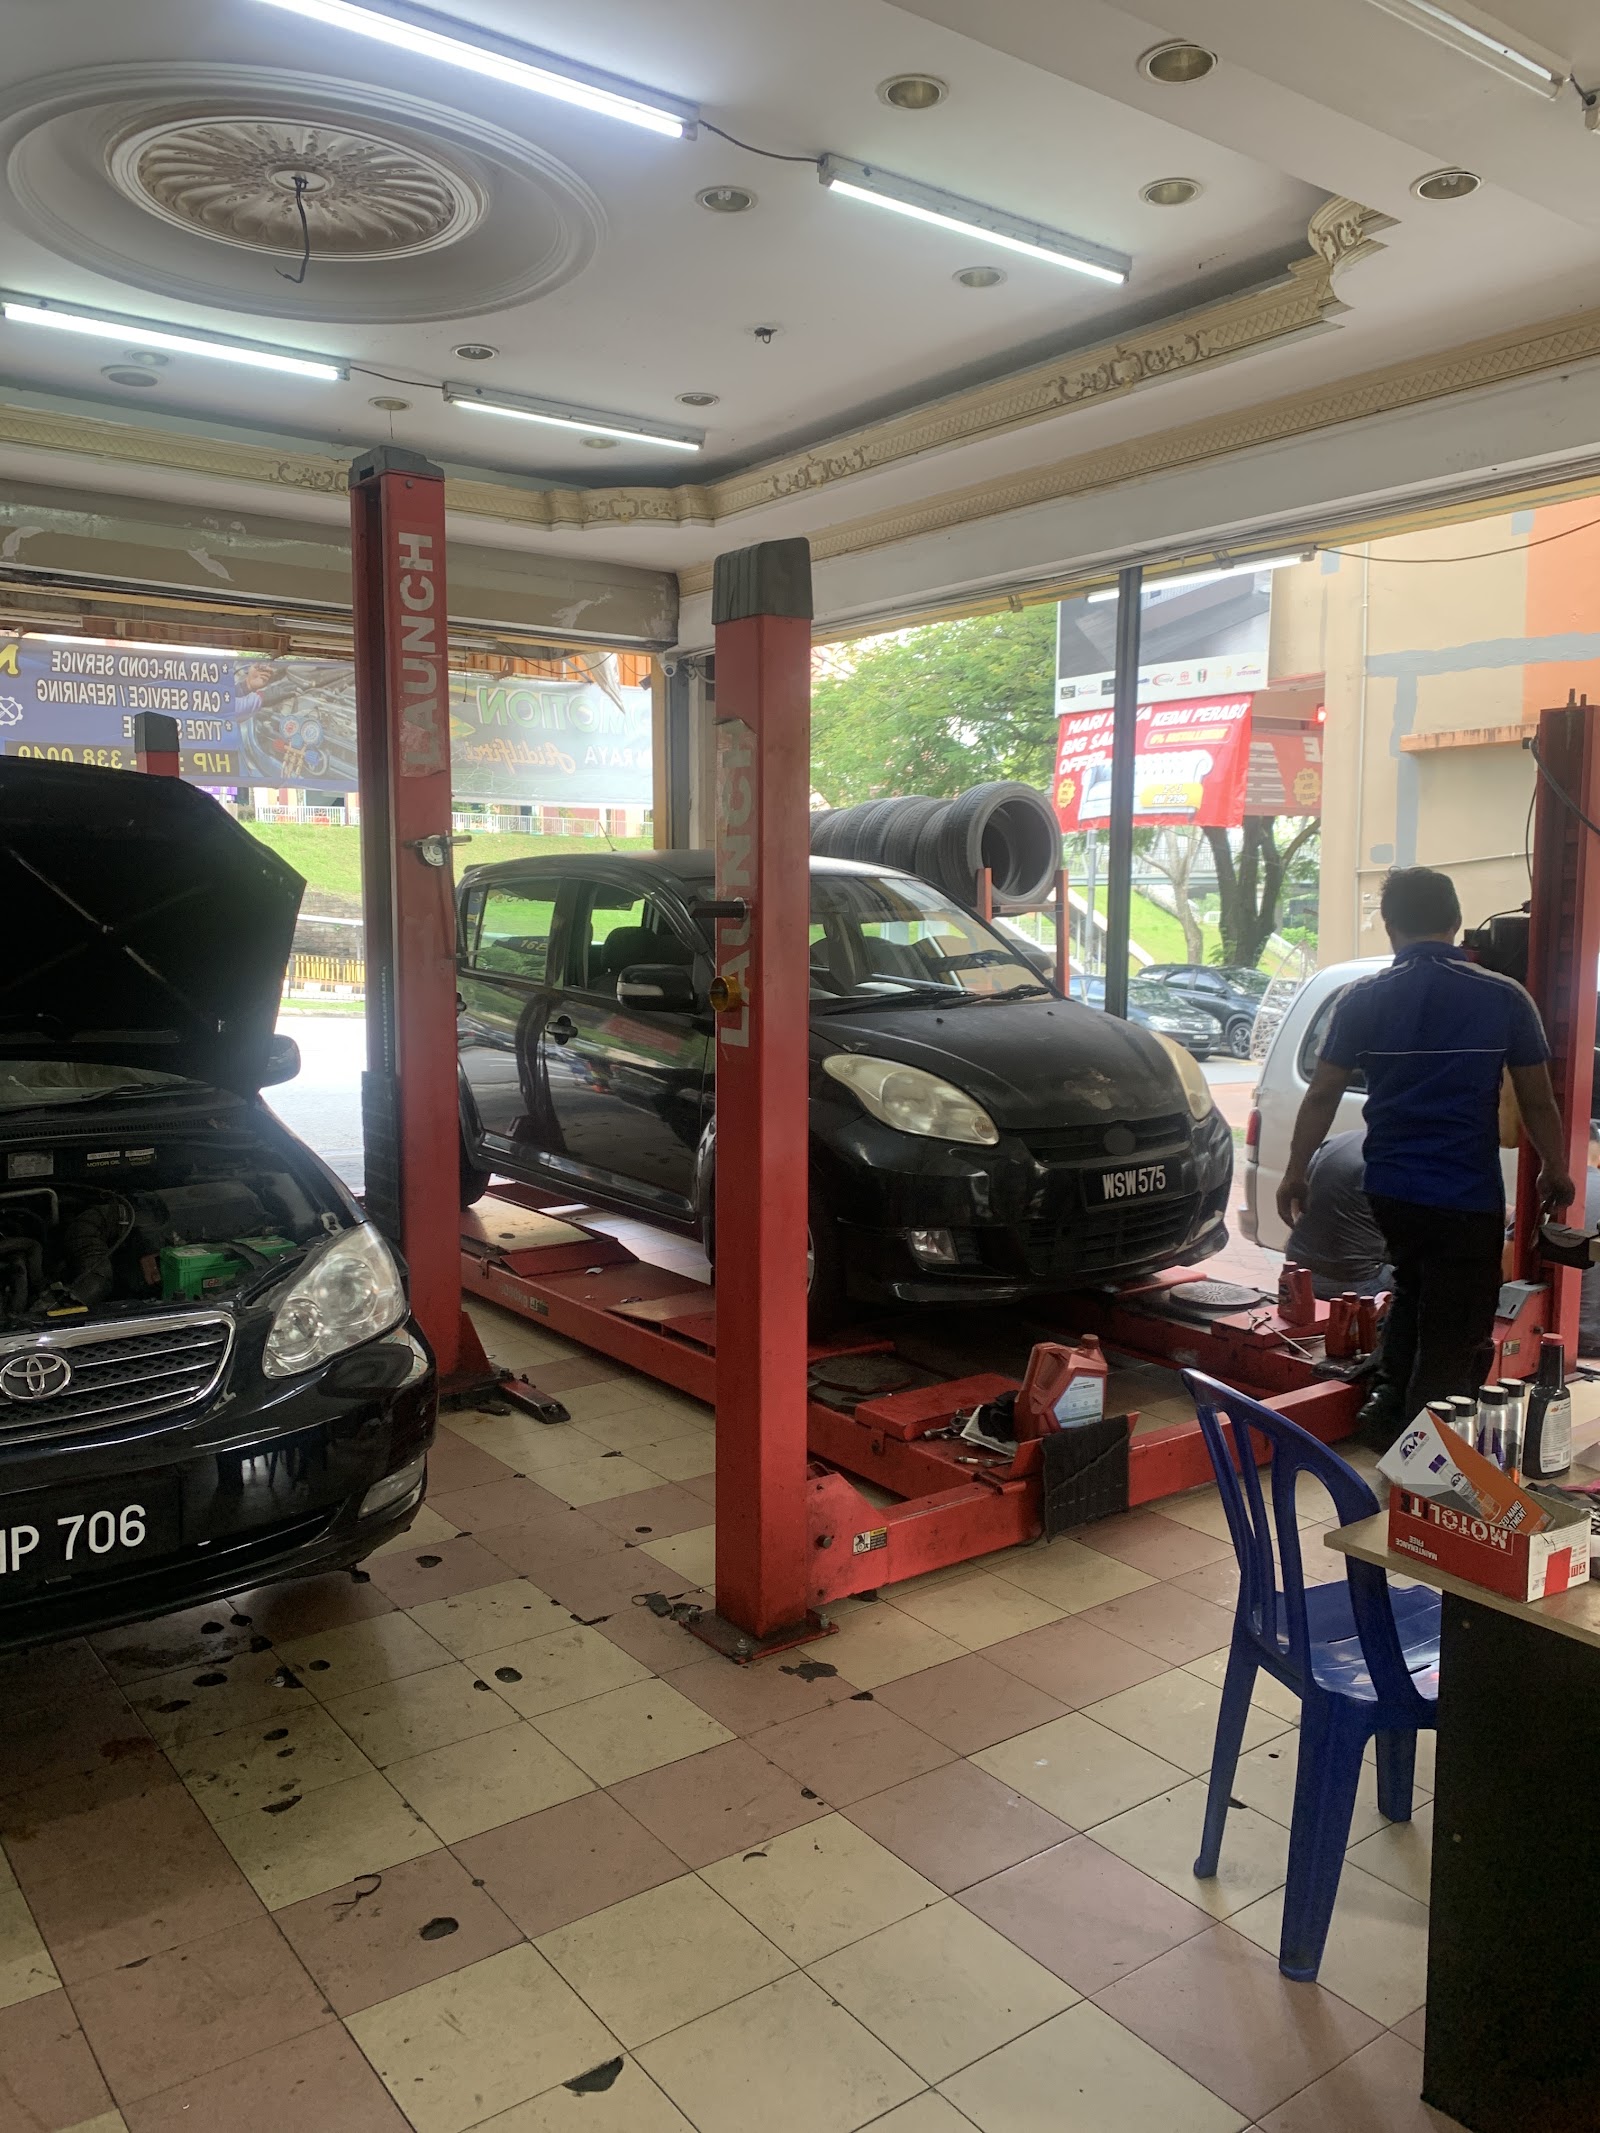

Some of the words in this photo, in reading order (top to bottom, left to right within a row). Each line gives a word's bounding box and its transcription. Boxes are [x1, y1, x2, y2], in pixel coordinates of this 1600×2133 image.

[398, 531, 442, 765] LAUNCH
[1191, 702, 1249, 723] PERABO
[1060, 736, 1088, 756] BIG
[57, 1504, 147, 1561] 706
